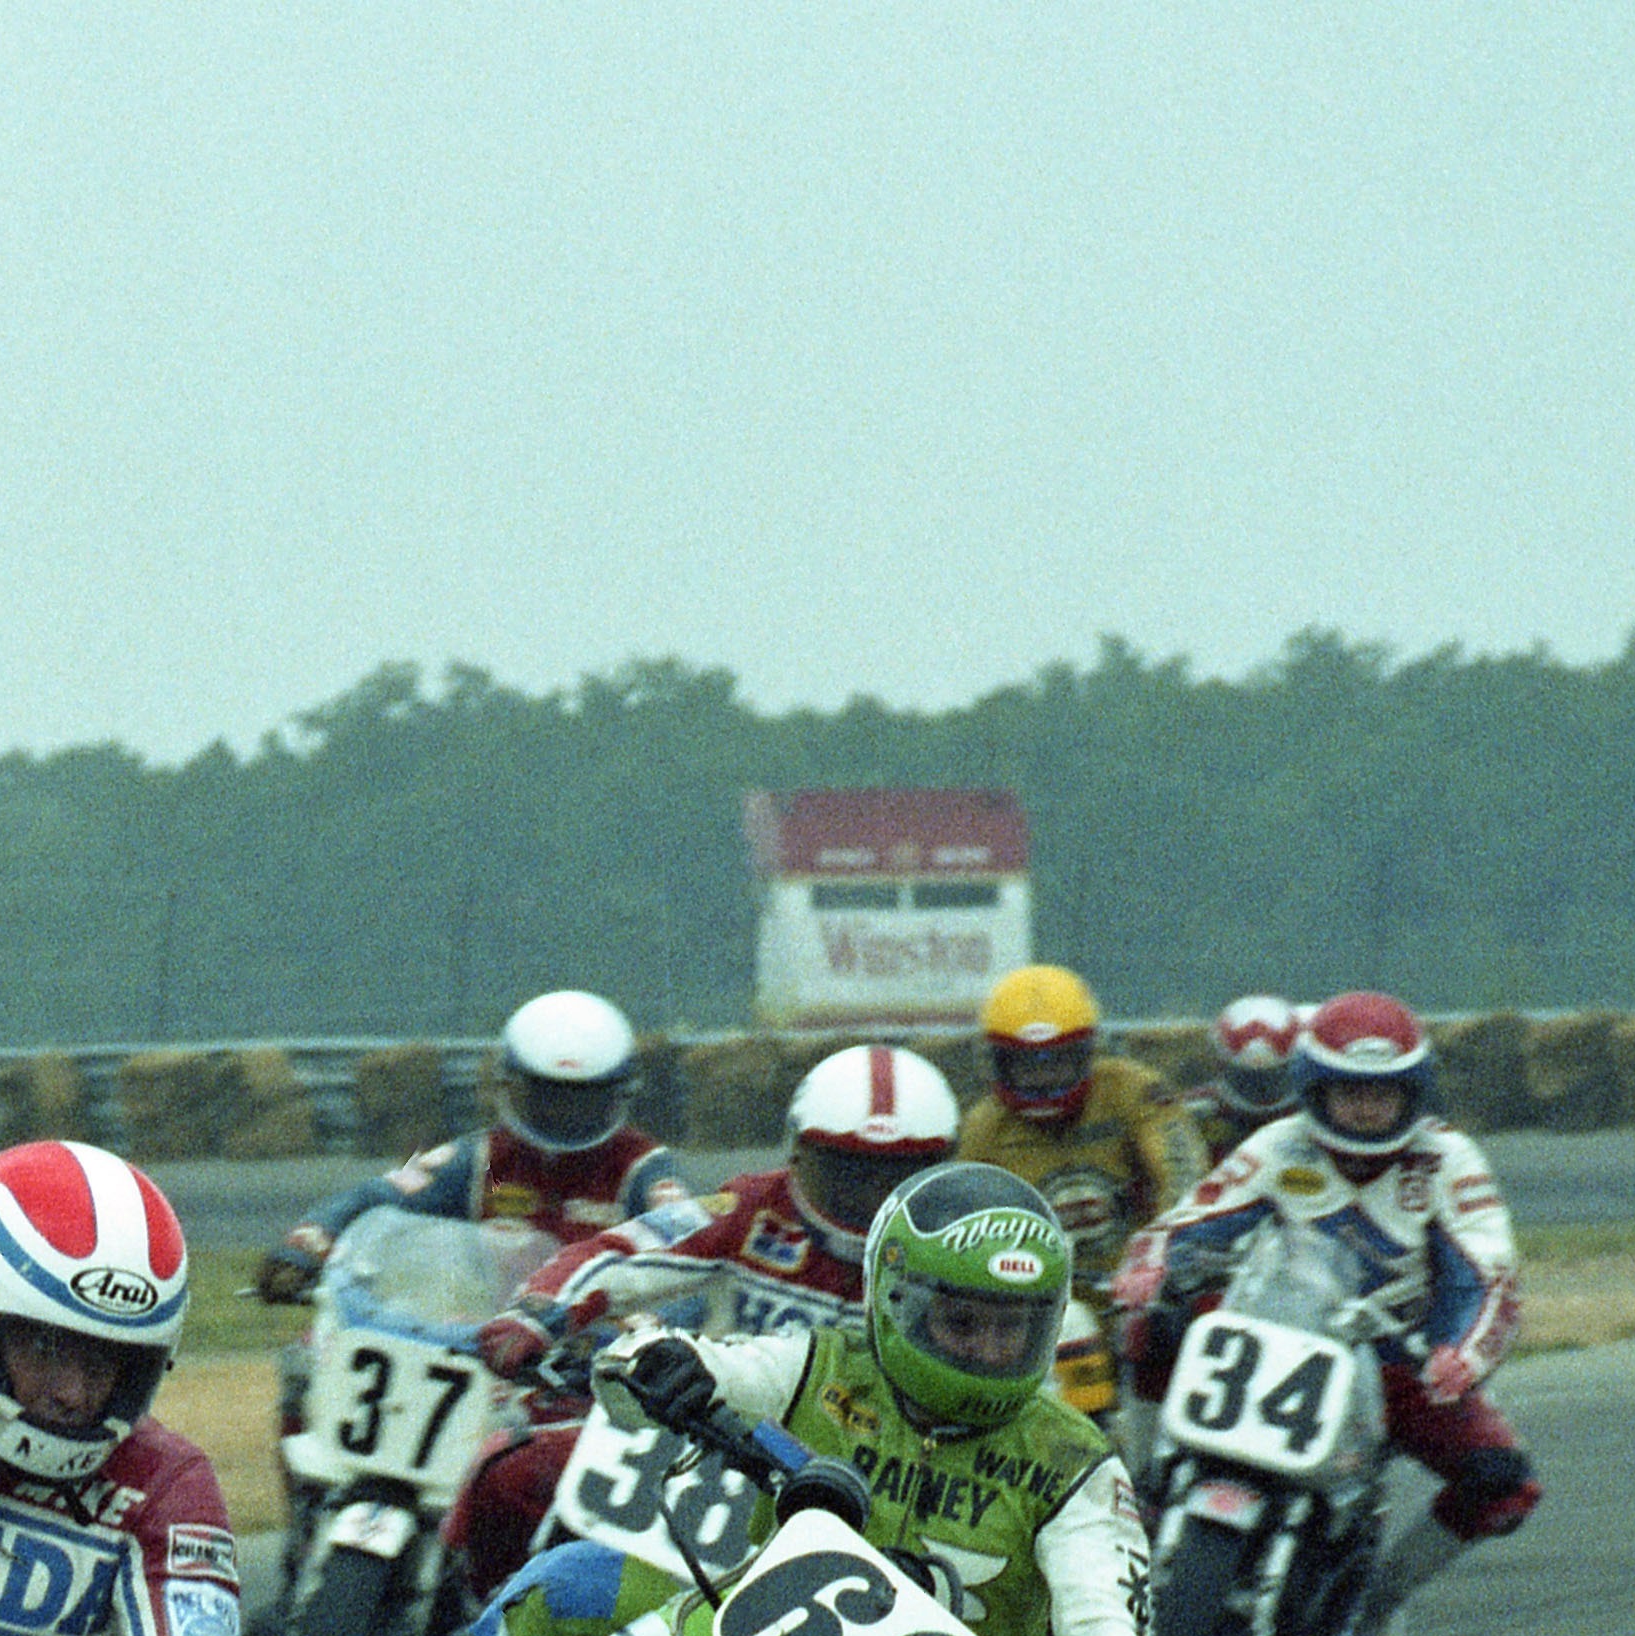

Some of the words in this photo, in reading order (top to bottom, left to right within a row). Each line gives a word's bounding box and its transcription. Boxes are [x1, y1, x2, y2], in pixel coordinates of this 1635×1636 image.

[942, 1214, 1057, 1252] Wayne
[999, 1260, 1036, 1273] BELL
[78, 1272, 149, 1304] Arai
[338, 1348, 472, 1470] 37
[1186, 1326, 1337, 1455] 34
[577, 1422, 759, 1569] 38
[851, 1444, 1000, 1529] RAINEY
[973, 1448, 1063, 1503] WAYNE
